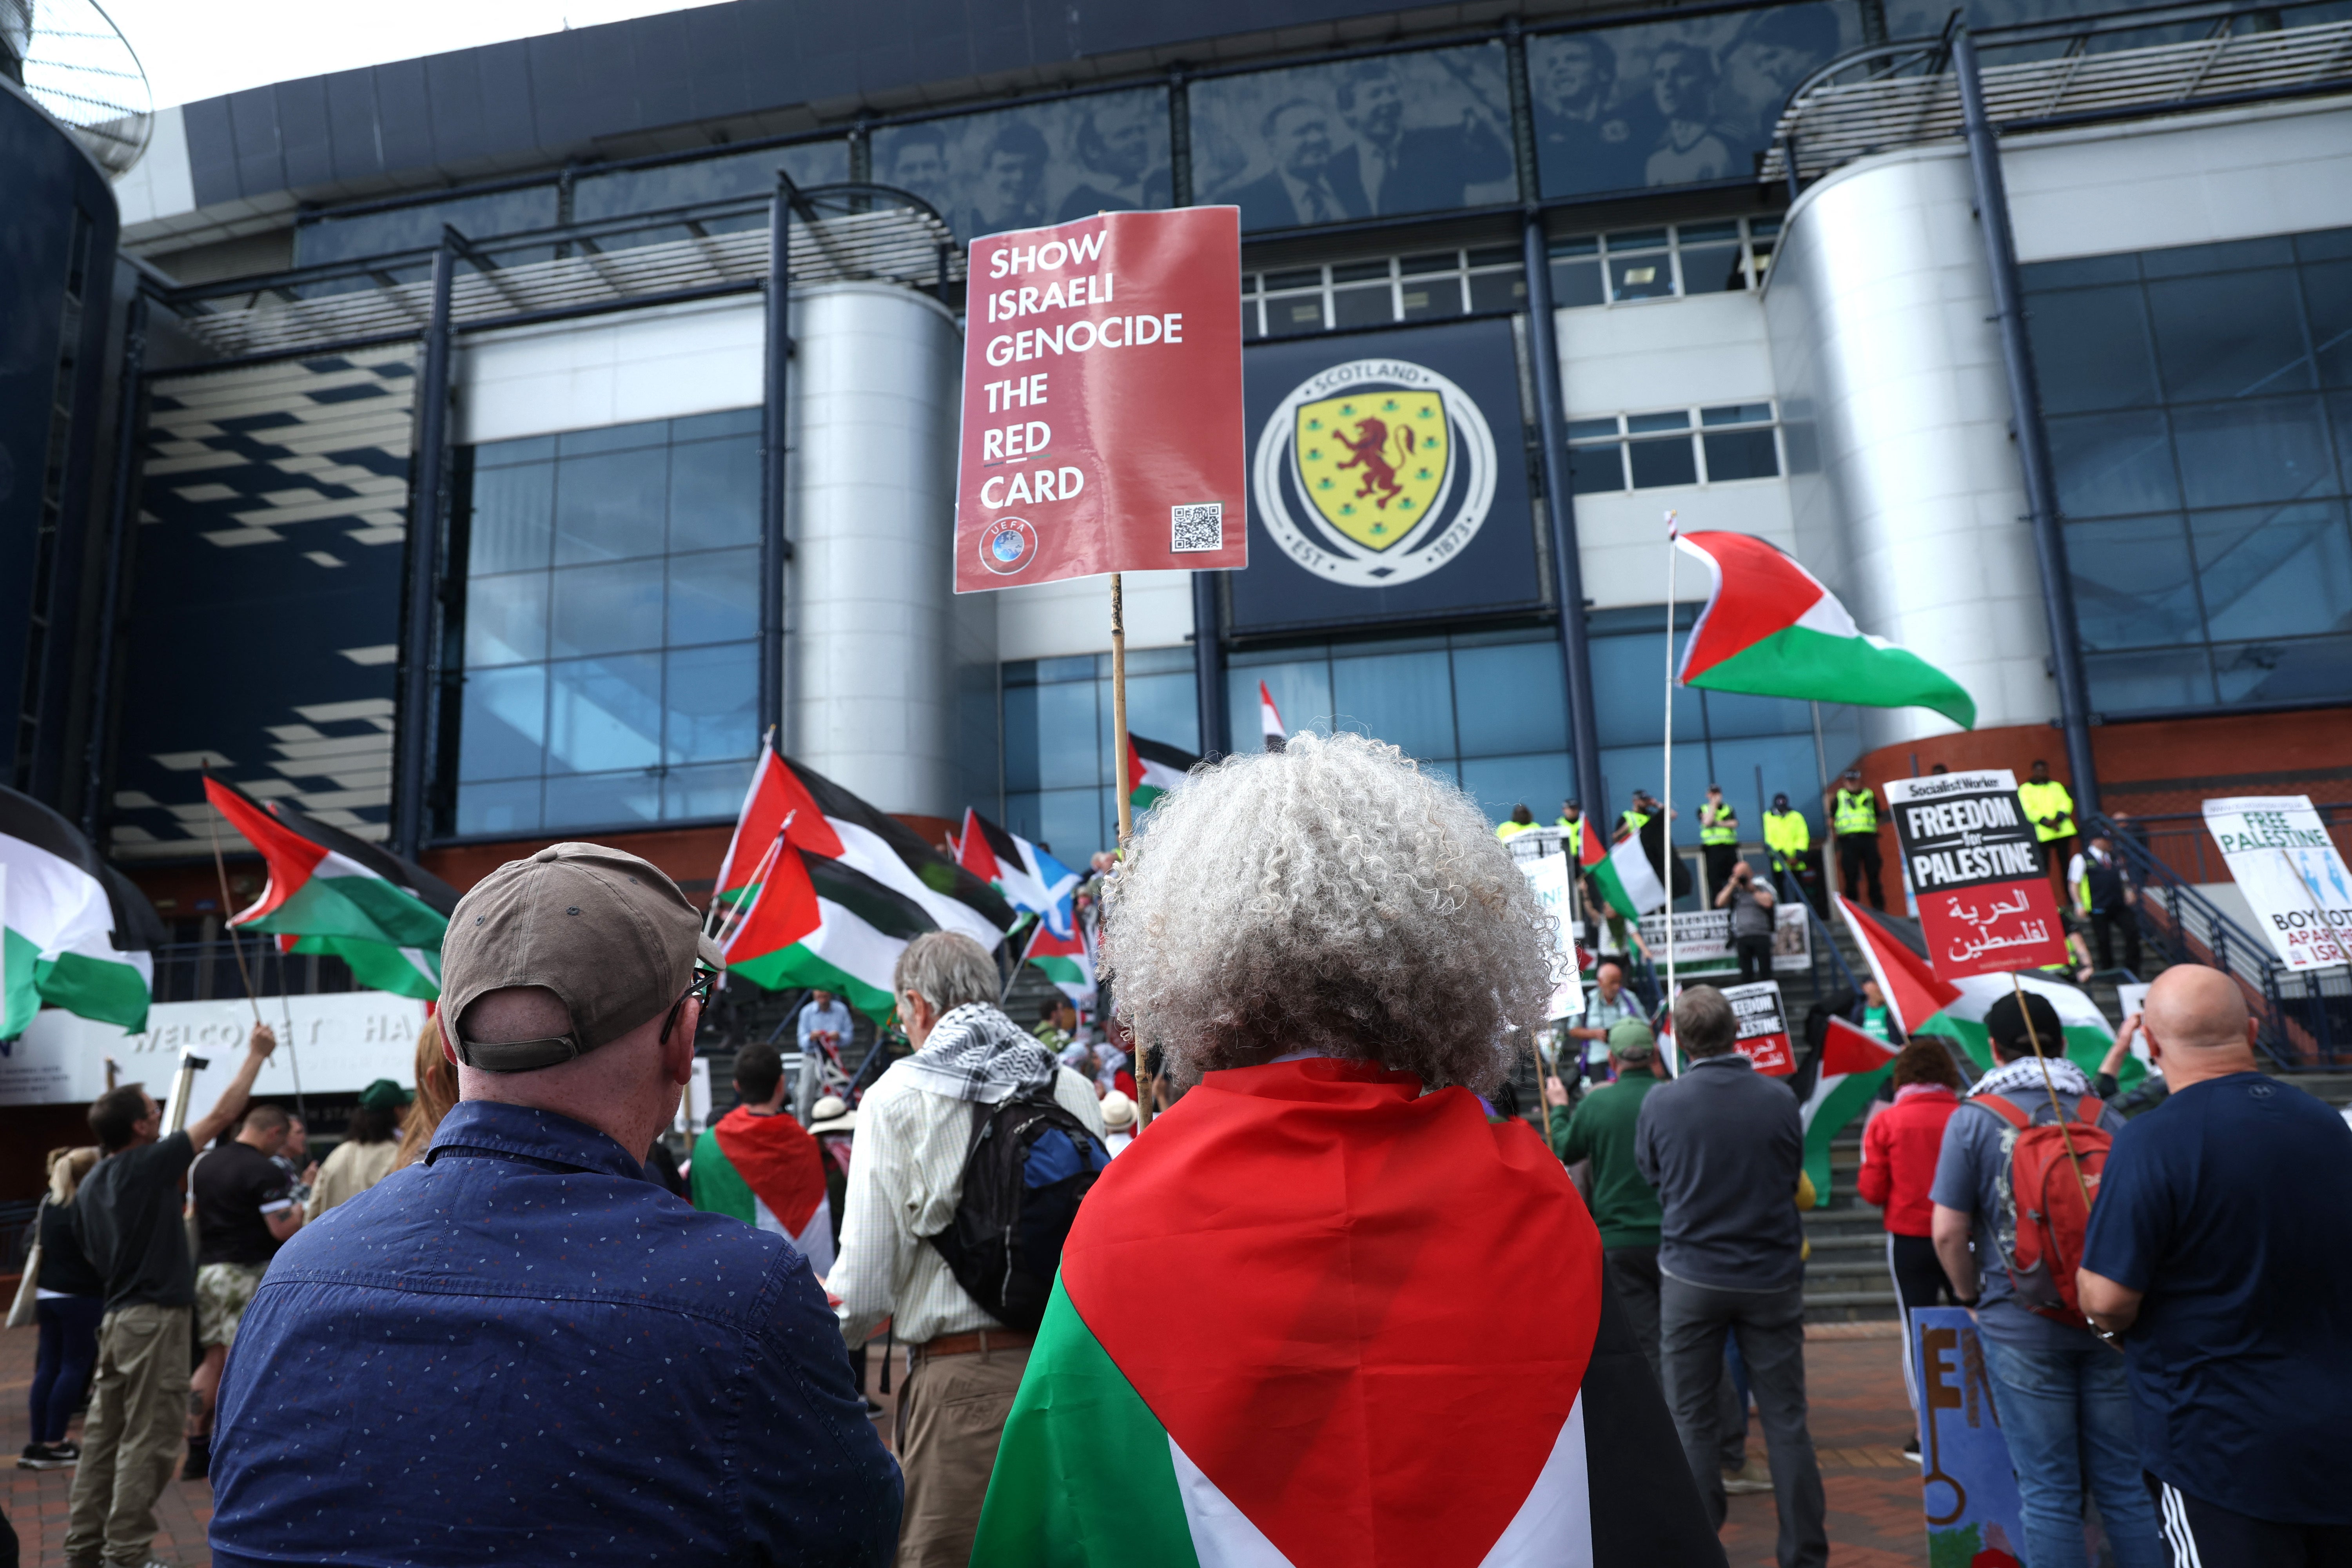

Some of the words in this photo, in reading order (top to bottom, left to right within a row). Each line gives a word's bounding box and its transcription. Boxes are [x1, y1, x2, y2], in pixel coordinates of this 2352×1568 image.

[988, 230, 1107, 279] SHOW
[988, 272, 1113, 323] ISRAELI
[986, 313, 1182, 367] GENOCIDE
[984, 373, 1047, 413] THE
[1315, 363, 1419, 392] SCOTLAND
[983, 421, 1051, 461] RED
[980, 466, 1084, 510] CARD
[990, 521, 1025, 535] UEFA
[1432, 523, 1471, 558] 1873
[1291, 539, 1323, 568] EST
[1909, 779, 1962, 797] Socialist
[1962, 777, 2000, 790] Worker
[1906, 796, 2019, 840] FREEDOM
[2241, 811, 2291, 829] FREE
[1961, 831, 1984, 847] for
[2221, 828, 2329, 852] PALESTINE
[1912, 841, 2039, 888] PALESTINE
[1946, 888, 2030, 925] الحرية
[1948, 918, 2051, 962] لفلسطين
[132, 1020, 291, 1054] WELCOE
[365, 1013, 424, 1044] HA
